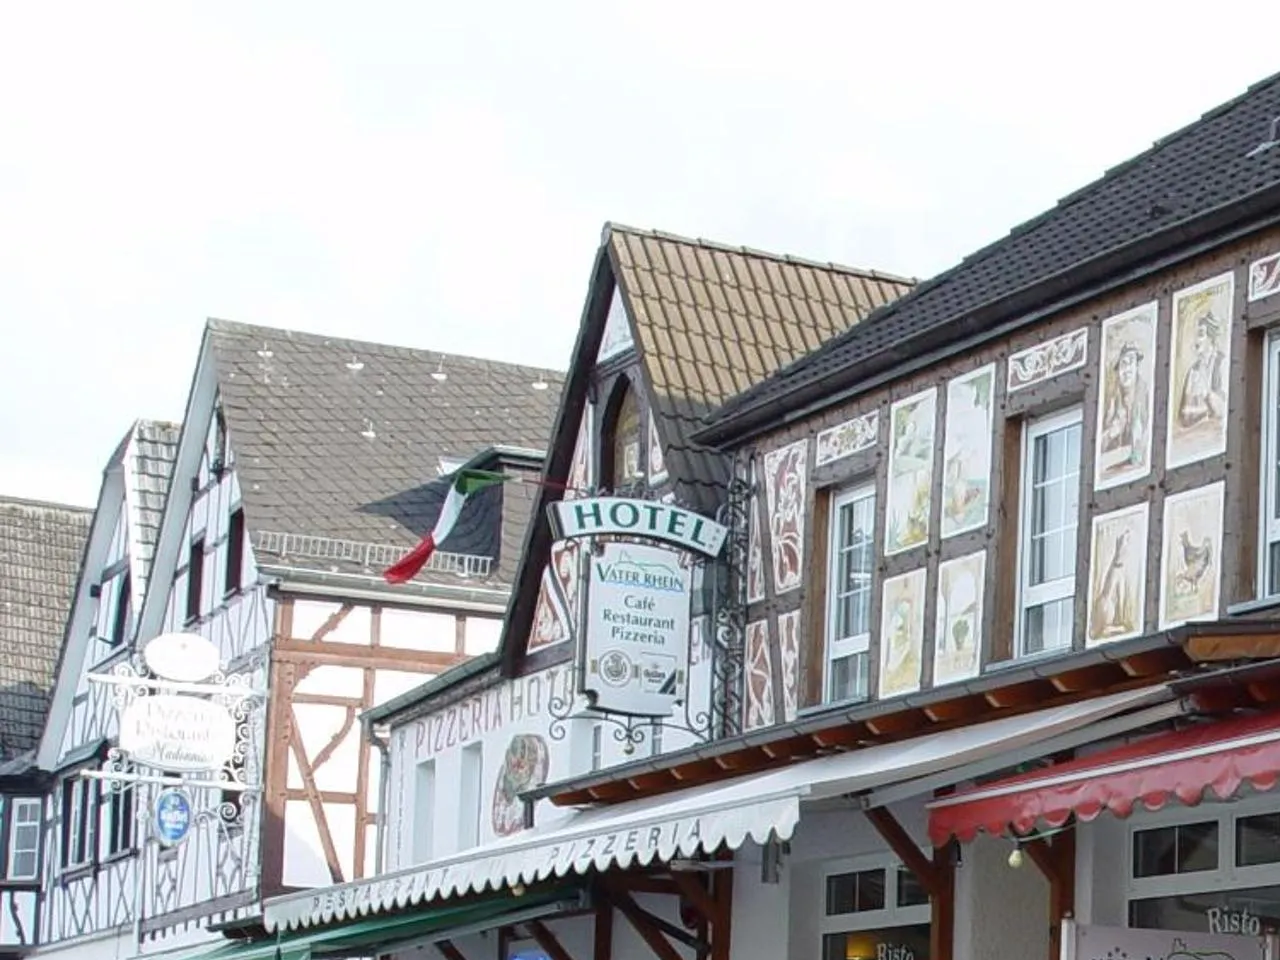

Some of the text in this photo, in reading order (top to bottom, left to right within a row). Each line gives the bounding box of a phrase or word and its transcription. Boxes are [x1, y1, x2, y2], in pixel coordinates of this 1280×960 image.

[574, 502, 708, 548] HOTEL
[596, 562, 684, 592] VATER RHEIN
[623, 594, 656, 612] Café
[603, 608, 676, 631] Restaurant
[611, 625, 666, 646] Pizzeria
[415, 691, 503, 760] PIZZERIA
[547, 818, 700, 867] PIZZERIA
[1207, 905, 1261, 935] Risto
